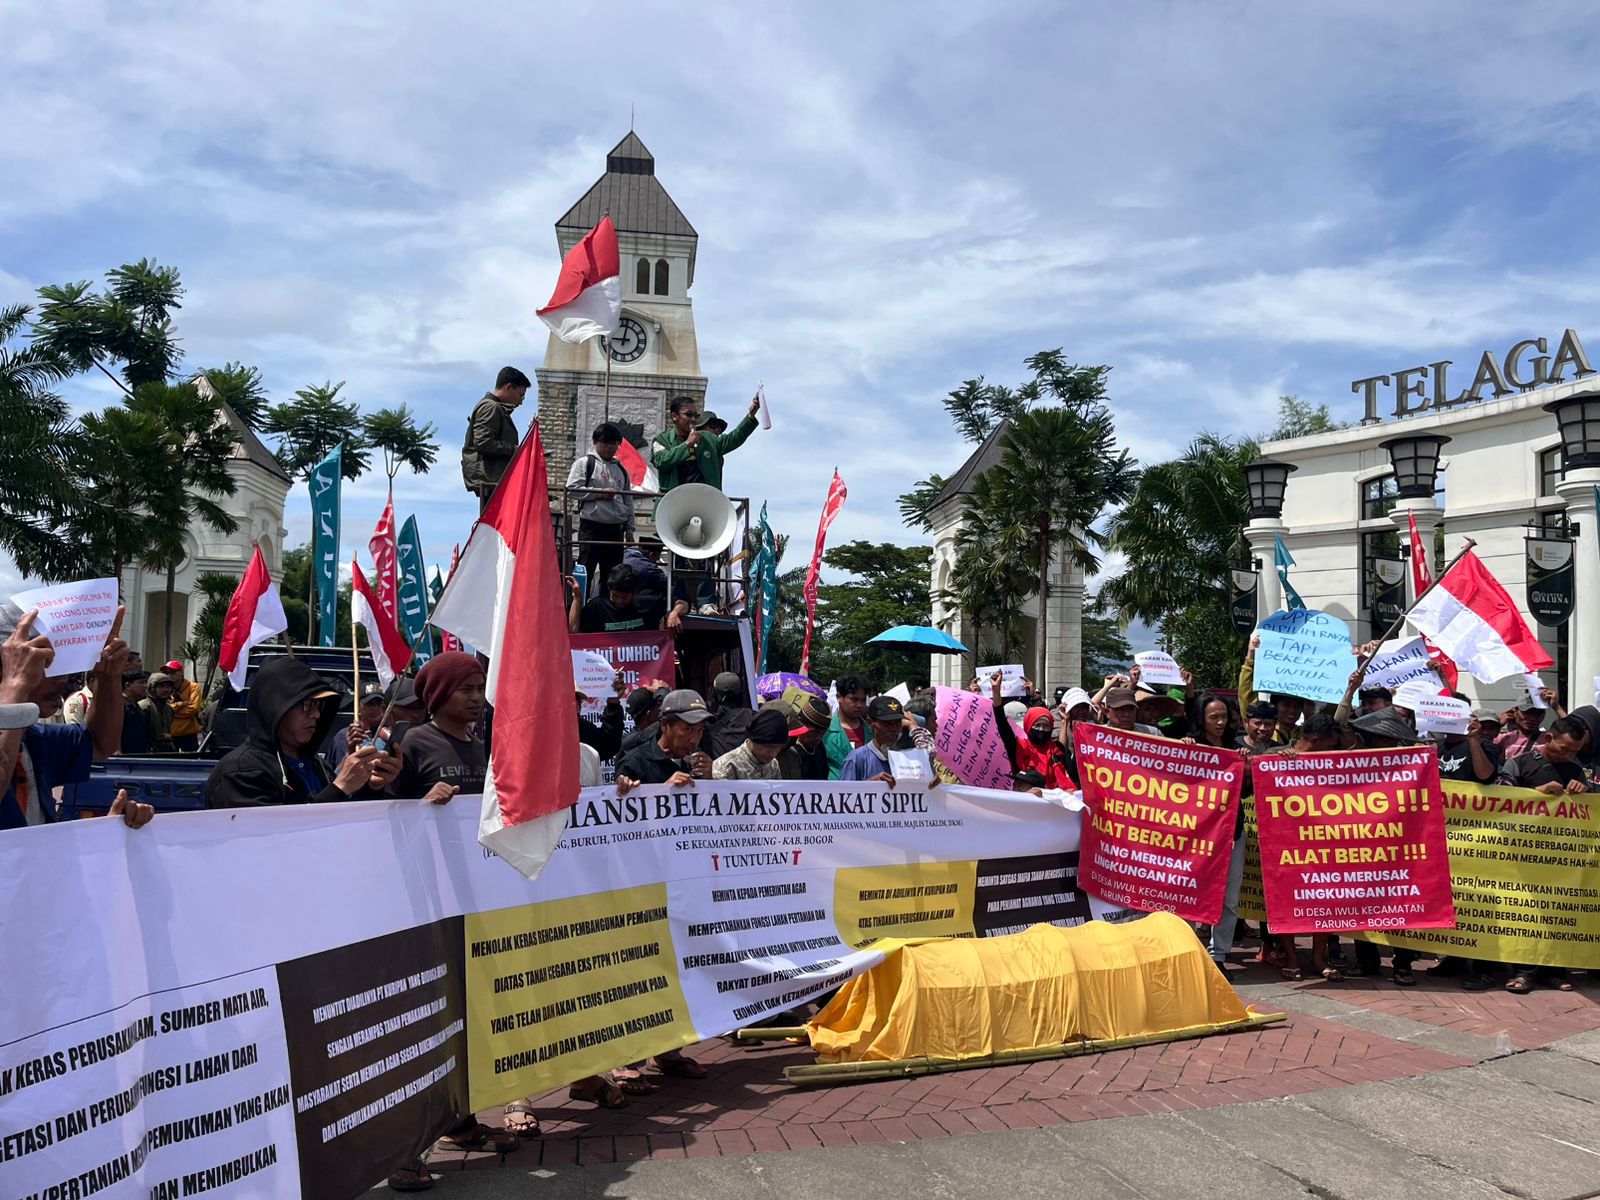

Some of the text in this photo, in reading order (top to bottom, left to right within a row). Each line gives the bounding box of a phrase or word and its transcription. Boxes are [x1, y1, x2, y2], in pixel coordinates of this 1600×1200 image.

[1352, 329, 1596, 423] TELAGA
[50, 609, 81, 619] TOLONG
[51, 625, 70, 634] KAMI
[86, 621, 107, 629] OKNUM
[54, 636, 87, 648] BAYARAN
[1280, 637, 1317, 655] TAPI
[618, 645, 660, 663] UNHRC
[1276, 666, 1331, 680] UNTUK
[938, 692, 962, 752] BATALKAN
[953, 696, 980, 765] SHGB DAN
[1096, 732, 1220, 764] PAK PRESIDEN KITA
[962, 750, 978, 777] IZIN
[1080, 744, 1234, 783] BP PRABOWO SUBIANTO
[1259, 753, 1430, 772] GUBERNUR JAWA BARAT
[1083, 762, 1189, 803] TOLONG
[1275, 770, 1417, 787] KANG DEDI MULYADI
[654, 791, 928, 820] BELA MASYARAKAT SIPIL
[1104, 797, 1198, 830] HENTIKAN
[1266, 792, 1389, 818] TOLONG
[1472, 795, 1550, 817] UTAMA
[1554, 801, 1590, 820] AKSI
[570, 837, 610, 849] BURUH,
[612, 831, 642, 843] TOKOH
[718, 823, 756, 834] ADVOKAT,
[757, 822, 802, 832] KELOMPOK
[823, 821, 865, 831] MAHASISWA,
[1092, 816, 1189, 852] ALAT BERAT
[1299, 822, 1403, 841] HENTIKAN
[1462, 818, 1552, 835] DAN MASUK SECARA
[675, 835, 833, 851] SE KECAMATAN PARUNG KAB. BOGOR
[1475, 834, 1577, 852] JAWAB ATAS BERBAGAI
[724, 852, 789, 868] TUNTUTAN
[1100, 840, 1193, 872] YANG MERUSAK
[1279, 846, 1399, 865] ALAT BERAT
[1463, 848, 1568, 866] KE HILIR DAN MERAMPAS
[1094, 854, 1198, 889] LINGKUNGAN KITA
[1301, 869, 1410, 884] YANG MERUSAK
[736, 882, 806, 900] KEPADA AGAR
[1055, 892, 1075, 903] TERLIBAT
[1113, 879, 1197, 905] IWUL KECAMATAN
[1294, 885, 1421, 900] LINGKUNGAN KITA
[1457, 876, 1598, 898] DPR/MPR MELAKUKAN INVESTIGASI
[1100, 889, 1176, 914] PARUNG BOGOR
[1294, 904, 1425, 917] DI DESA IWUL KECAMATAN
[1476, 894, 1579, 912] YANG TERJADI DI TANAH
[688, 913, 788, 937] MEMPERTAHANKAN FUNGSI LAHAN
[1315, 918, 1406, 928] PARUNG BOGOR
[1472, 908, 1577, 926] DARI BERBAGAI INSTANSI
[472, 917, 625, 958] MENOLAK KERAS PEMBANGUNAN
[1426, 933, 1448, 944] DAN
[1450, 935, 1477, 948] SIDAK
[1487, 924, 1594, 943] KEMENTRIAN LINGKUNGAN
[494, 942, 660, 994] DIATAS EKS PTPN CIMULANG
[717, 974, 772, 993] RAKYAT DEMI
[491, 976, 669, 1035] YANG TELAH AKAN TERUS BERDAMPAK PADA
[732, 996, 781, 1021] EKONOMI DAN
[16, 1051, 67, 1089] KERAS
[161, 1001, 221, 1034] SUMBER
[223, 993, 250, 1018] MATA
[251, 988, 269, 1010] AIR,
[494, 1009, 674, 1075] BENCANA ALAM DAN MERUGIKAN MASYARAKAT
[56, 1043, 258, 1142] DAN LAHAN DARI
[297, 1073, 360, 1114] MASYARAKAT SERTA
[148, 1084, 290, 1152] PEMUKIMAN YANG AKAN
[322, 1122, 337, 1142] DAN
[182, 1144, 277, 1196] MENIMBULKAN
